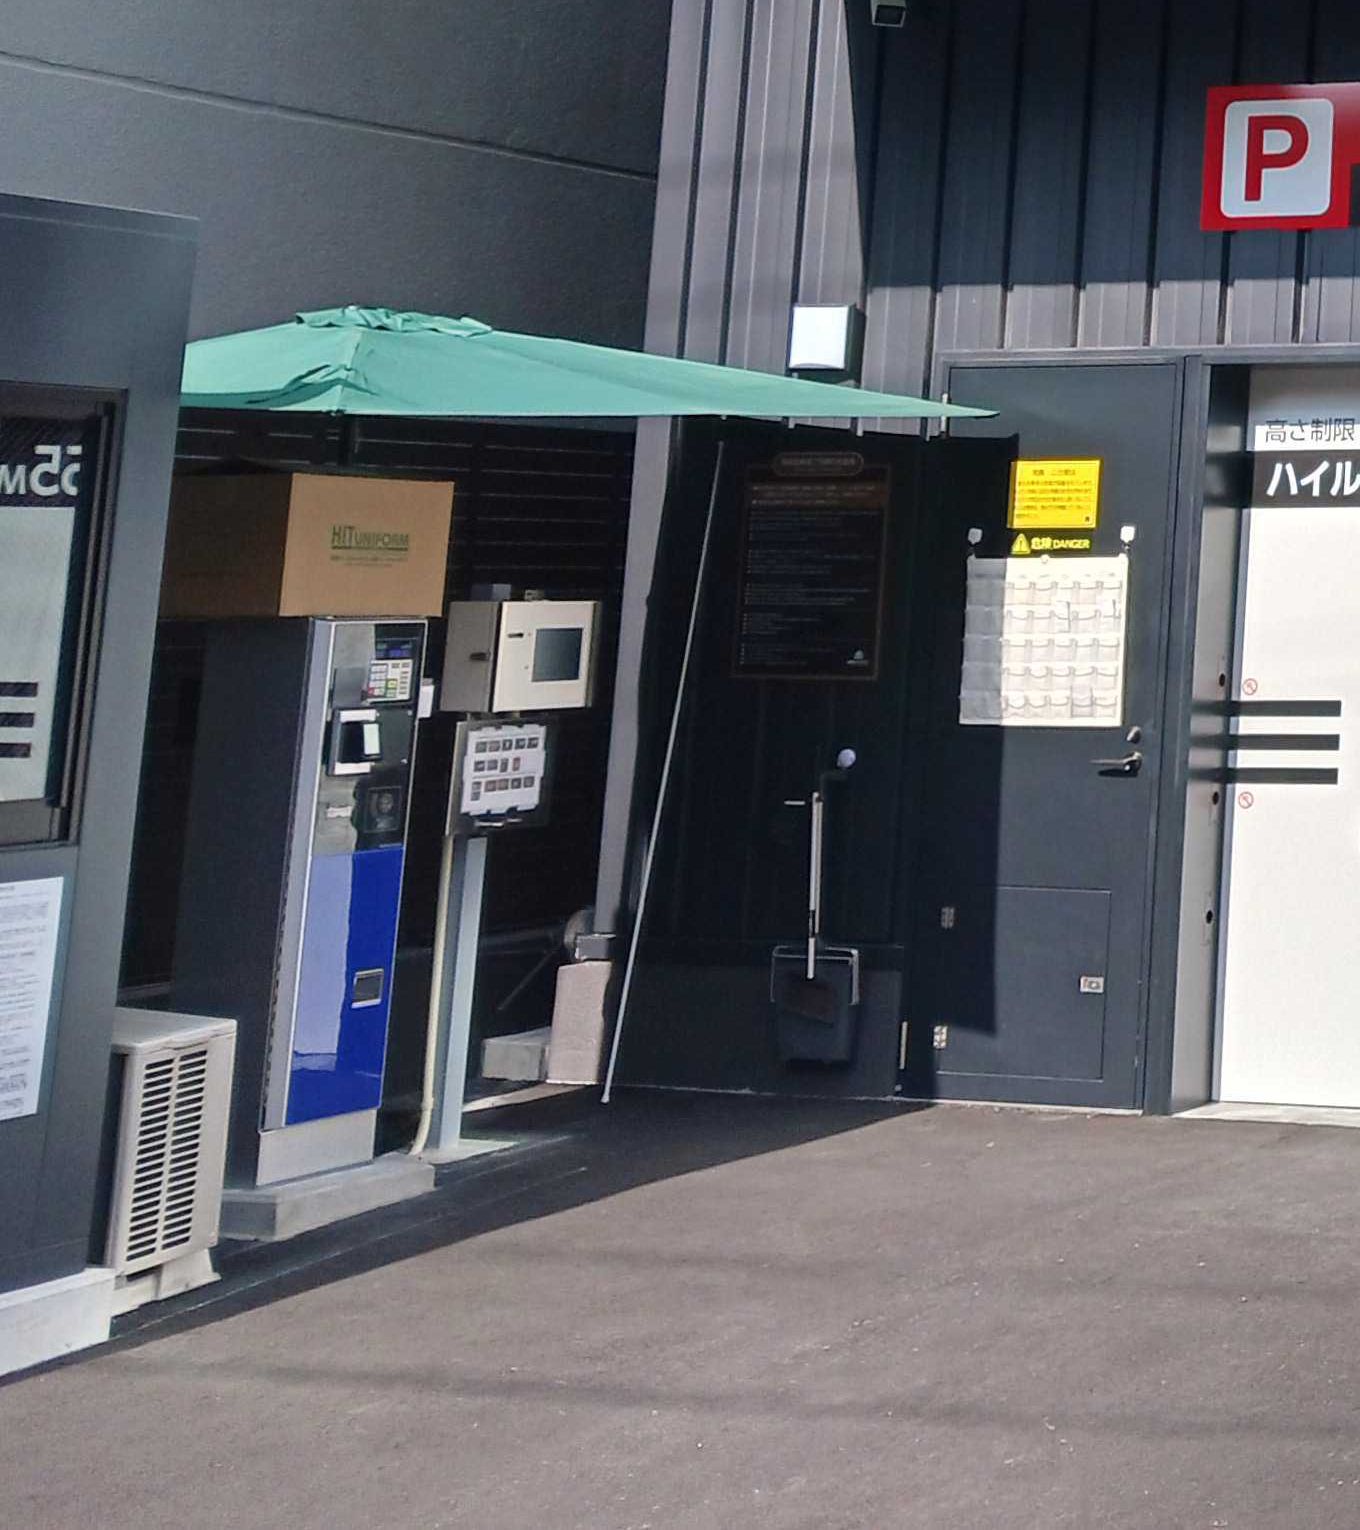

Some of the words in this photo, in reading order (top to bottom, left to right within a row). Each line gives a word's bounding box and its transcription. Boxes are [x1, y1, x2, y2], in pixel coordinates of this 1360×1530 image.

[1243, 113, 1310, 203] P
[1264, 417, 1356, 443] 高さ制限
[1053, 538, 1090, 549] DANGER
